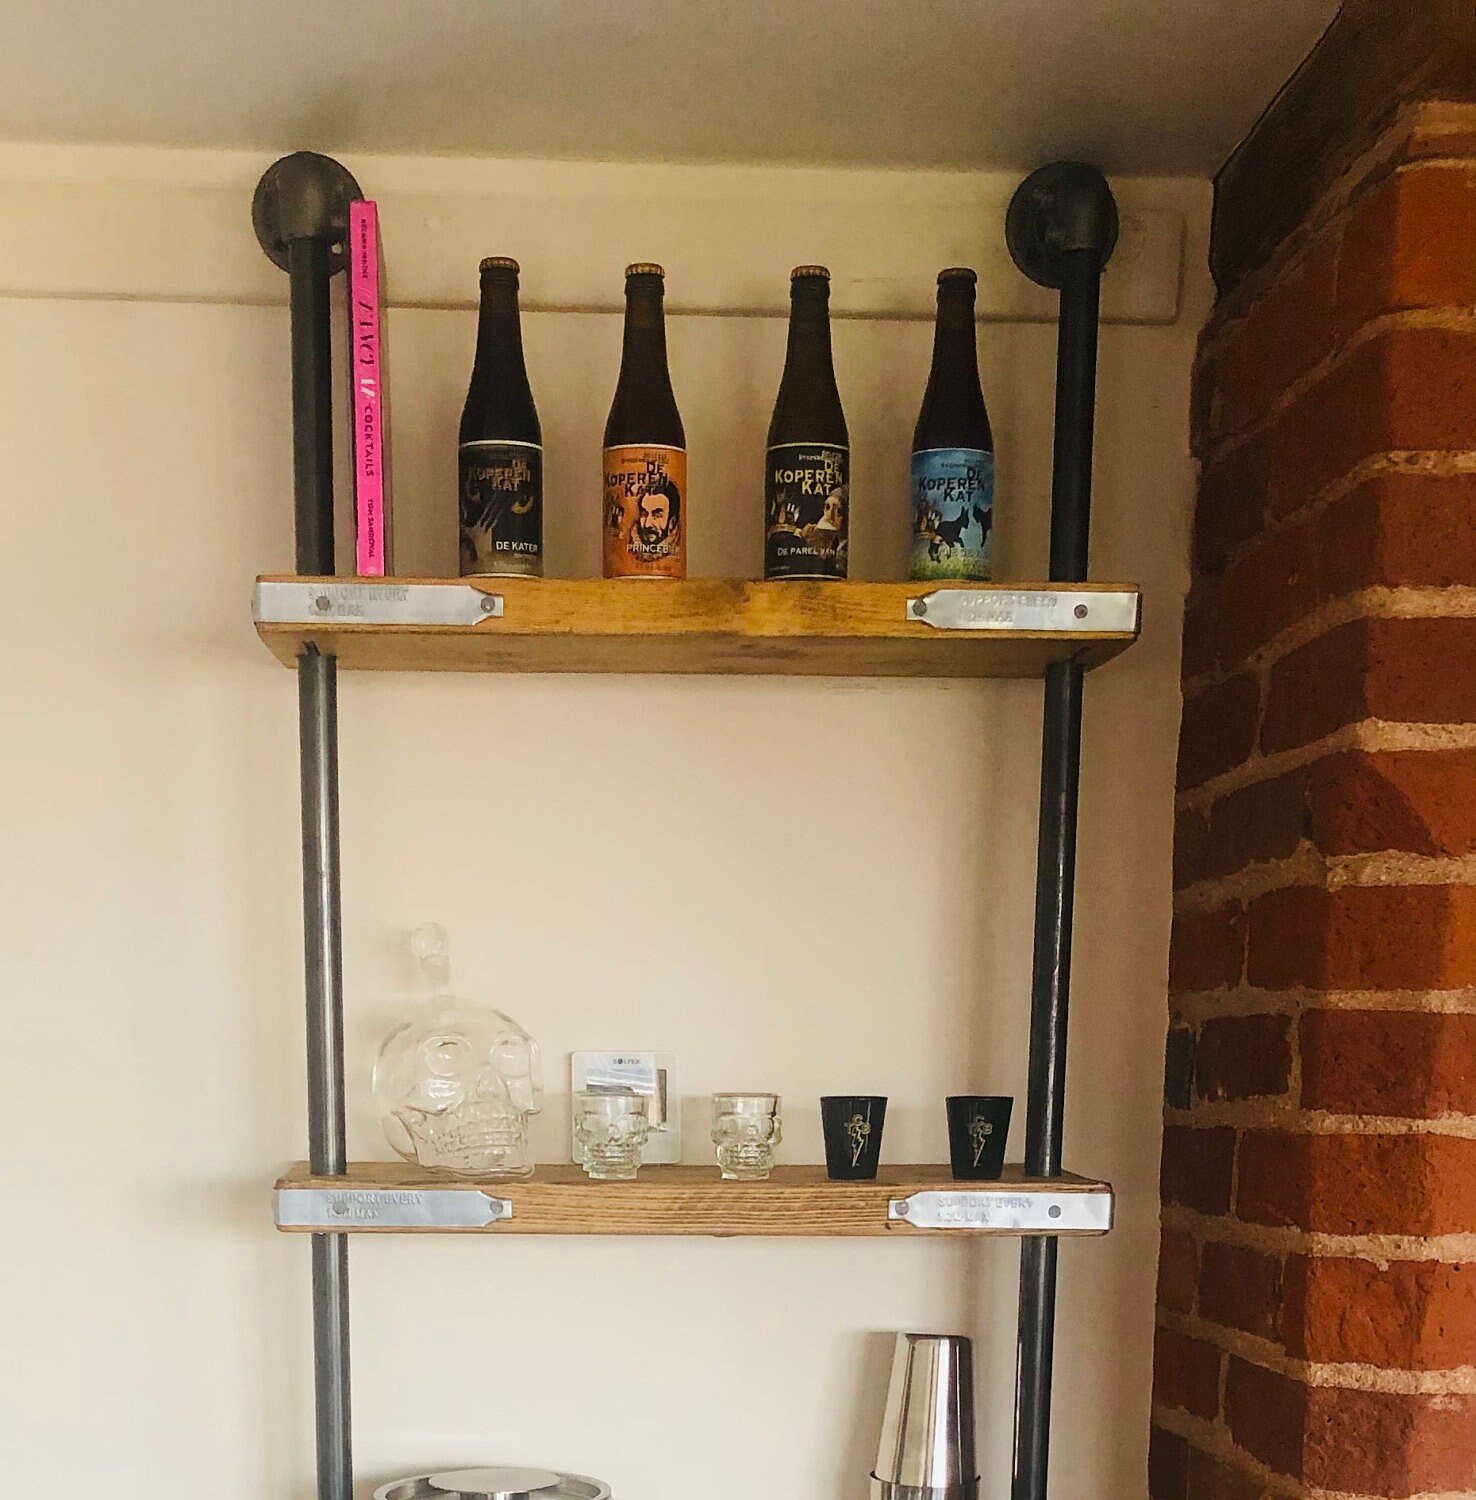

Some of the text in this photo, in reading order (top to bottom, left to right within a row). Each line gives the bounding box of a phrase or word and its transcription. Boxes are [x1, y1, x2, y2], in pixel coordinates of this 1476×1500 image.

[363, 404, 374, 478] COCKTAILS
[646, 461, 664, 474] DE
[825, 459, 840, 473] DE
[774, 469, 843, 485] KOPEREN
[801, 479, 832, 496] KAT
[944, 488, 974, 502] KAT
[495, 541, 538, 553] DE KATER
[777, 547, 789, 557] DE
[790, 546, 819, 555] PAREL
[383, 1192, 423, 1206] EVERY
